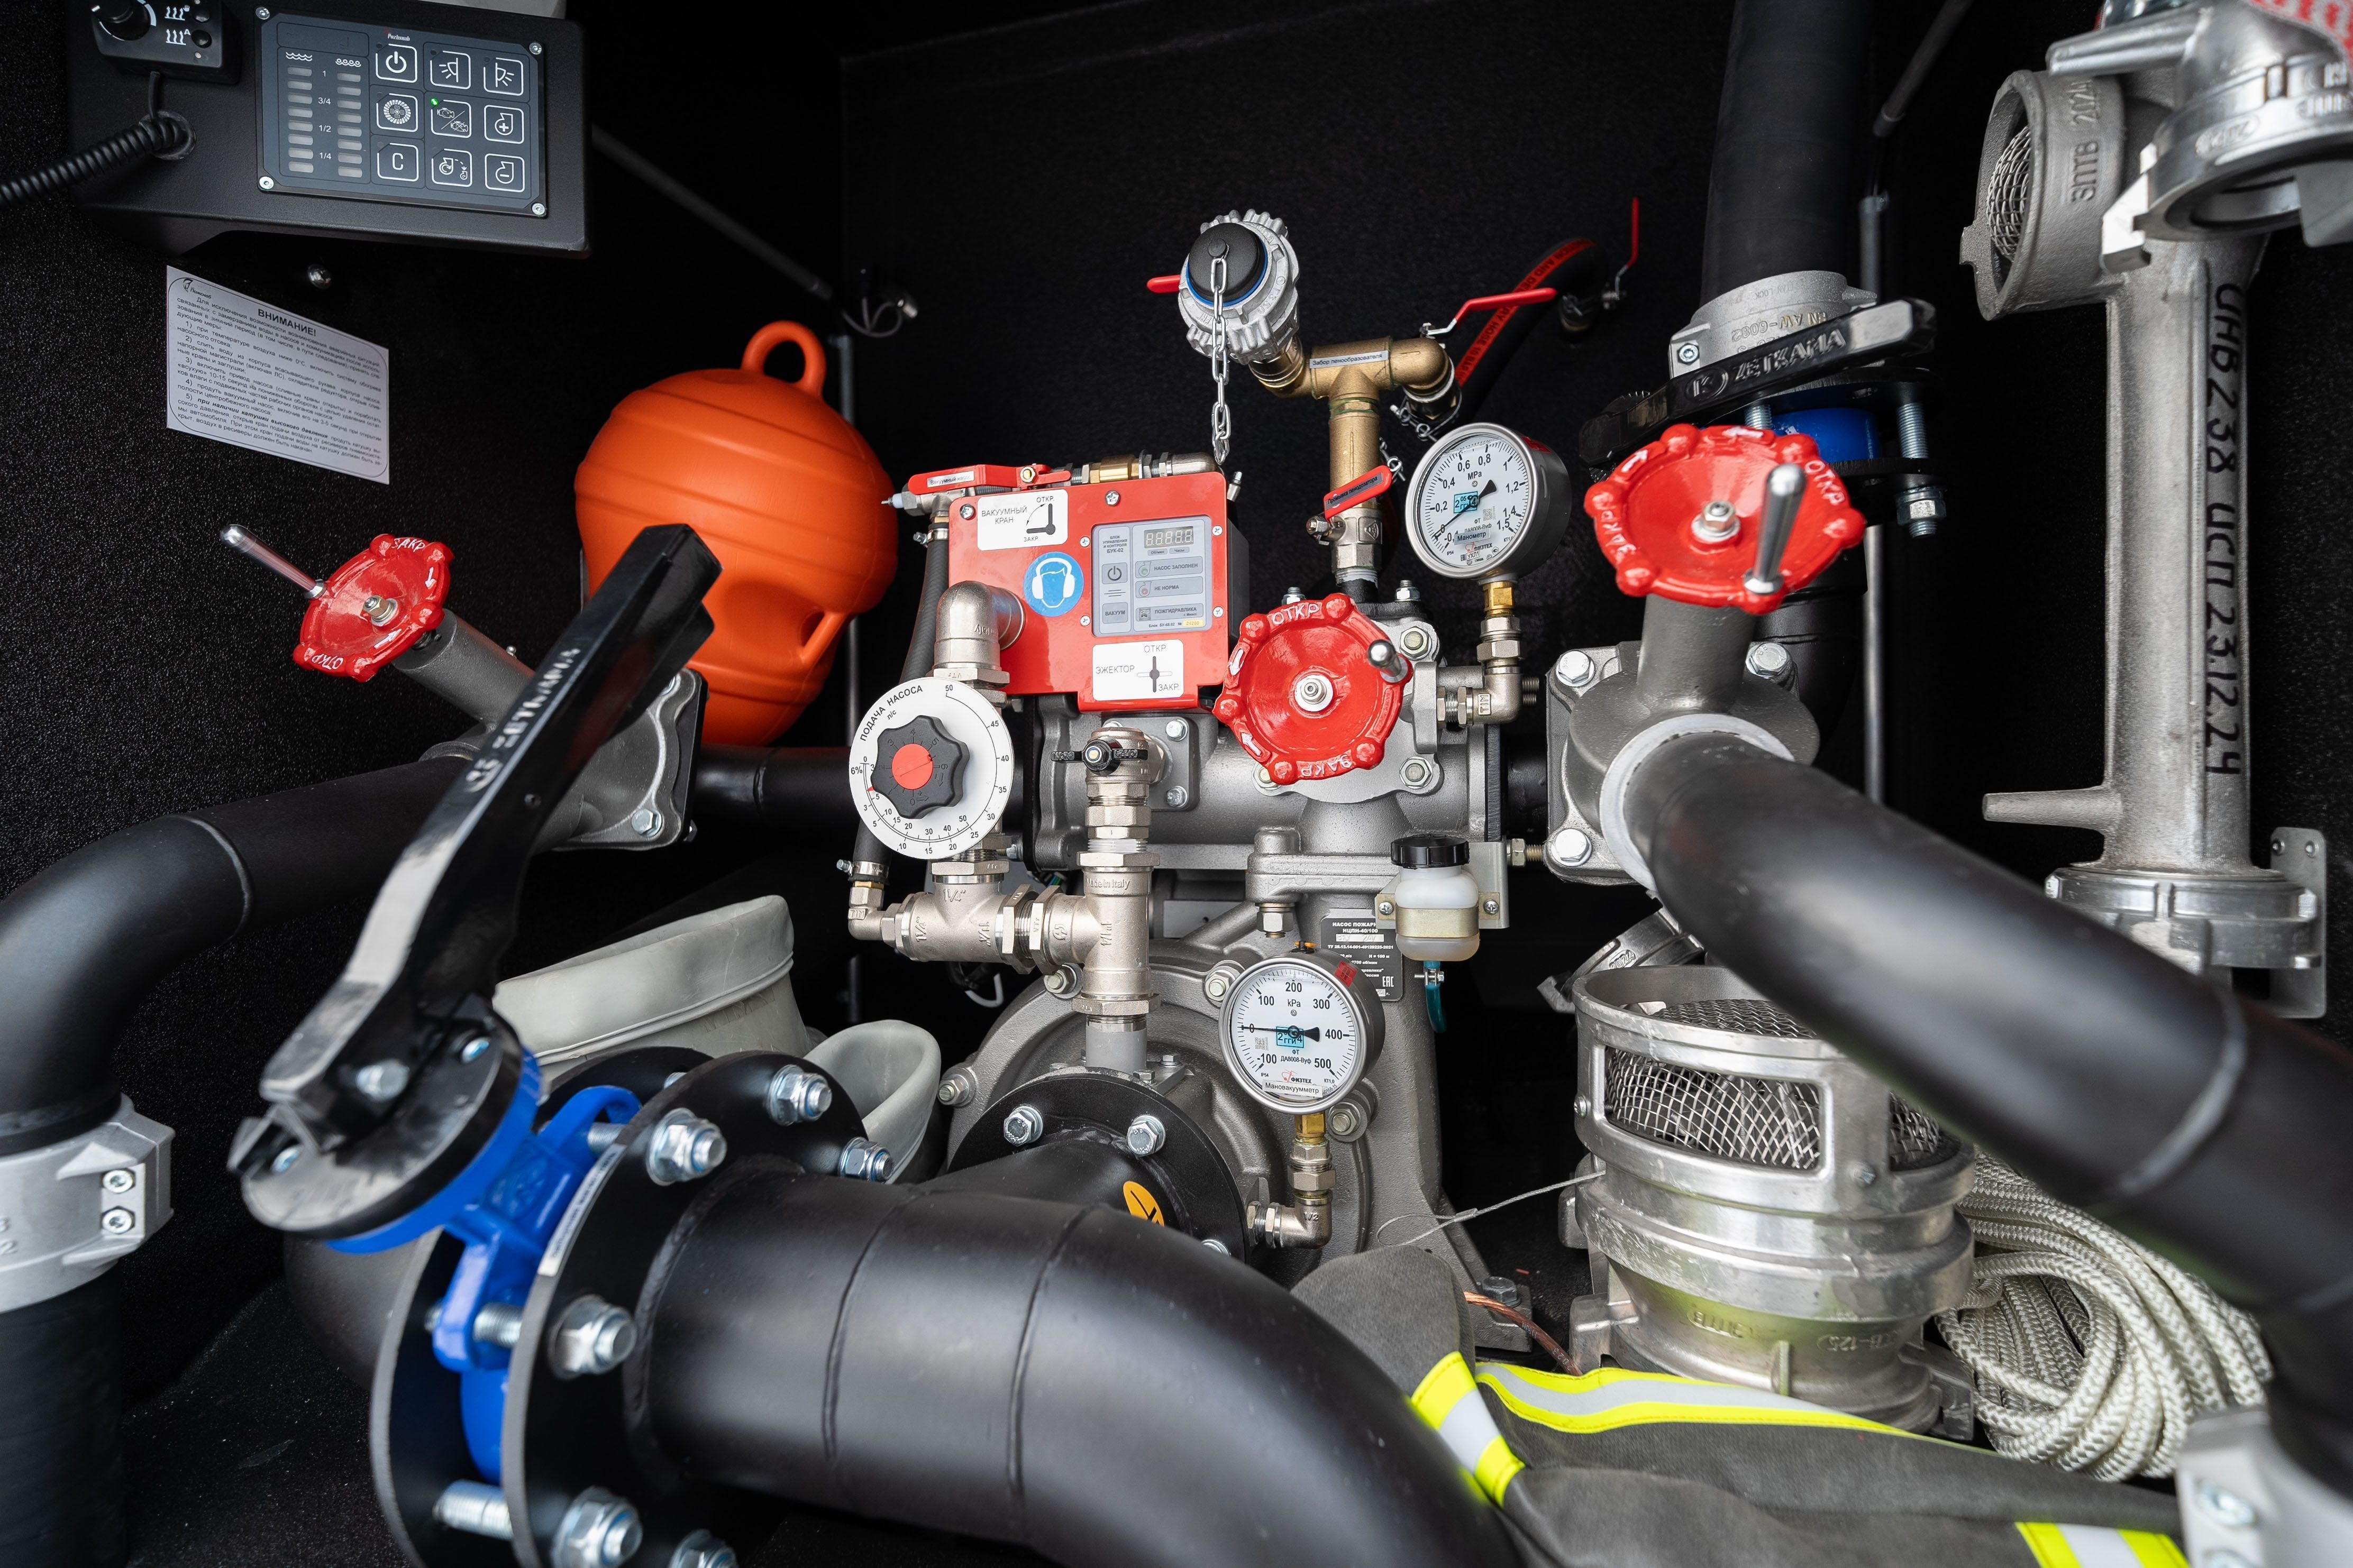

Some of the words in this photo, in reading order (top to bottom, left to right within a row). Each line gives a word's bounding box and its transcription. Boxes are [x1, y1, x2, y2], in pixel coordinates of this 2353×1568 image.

[197, 297, 209, 306] Для
[258, 308, 316, 337] ВНИМАНИЕ!
[1312, 357, 1329, 366] Забор
[1330, 354, 1382, 364] пенообразователя
[1478, 454, 1491, 466] 0,8
[1457, 460, 1470, 472] 0,6
[1503, 461, 1508, 471] 1
[1467, 471, 1482, 480] MPa
[1443, 477, 1455, 490] 0,4
[1506, 481, 1519, 494] 1,2
[1804, 459, 1845, 506] ОТКР
[1327, 490, 1348, 504] Промывка
[1349, 476, 1378, 494] пенодозатора
[982, 506, 1027, 517] ВАКУУМНЫЙ
[1435, 501, 1448, 512] 0,2
[1503, 505, 1517, 518] 1,4
[1497, 518, 1510, 531] 1,5
[1457, 531, 1486, 542] Манометр
[391, 537, 426, 553] ЗАКР
[1272, 602, 1320, 626] ОТКР
[312, 653, 344, 670] ОТКР
[1096, 665, 1135, 674] ЭЖЕКТОР
[2204, 601, 2242, 776] 23.12.24
[860, 707, 886, 741] ПОДАЧА
[887, 685, 923, 706] НАСОСА
[887, 709, 897, 720] л/с
[851, 765, 863, 775] 6%
[1300, 754, 1352, 777] ЗАКР
[1086, 878, 1102, 888] Made
[1103, 879, 1110, 888] in
[1111, 878, 1130, 891] Italy
[1285, 982, 1302, 992] 200
[1258, 995, 1274, 1005] 100
[1288, 999, 1301, 1007] kPa
[1313, 998, 1330, 1009] 300
[1249, 1023, 1254, 1033] 0
[1325, 1029, 1343, 1040] 400
[1257, 1053, 1277, 1064] -100
[1281, 1056, 1311, 1065] ДА8008-Вуф
[1314, 1058, 1331, 1069] 500
[1265, 1083, 1319, 1095] Мановакуумметр
[1303, 1211, 1319, 1221] 1/2
